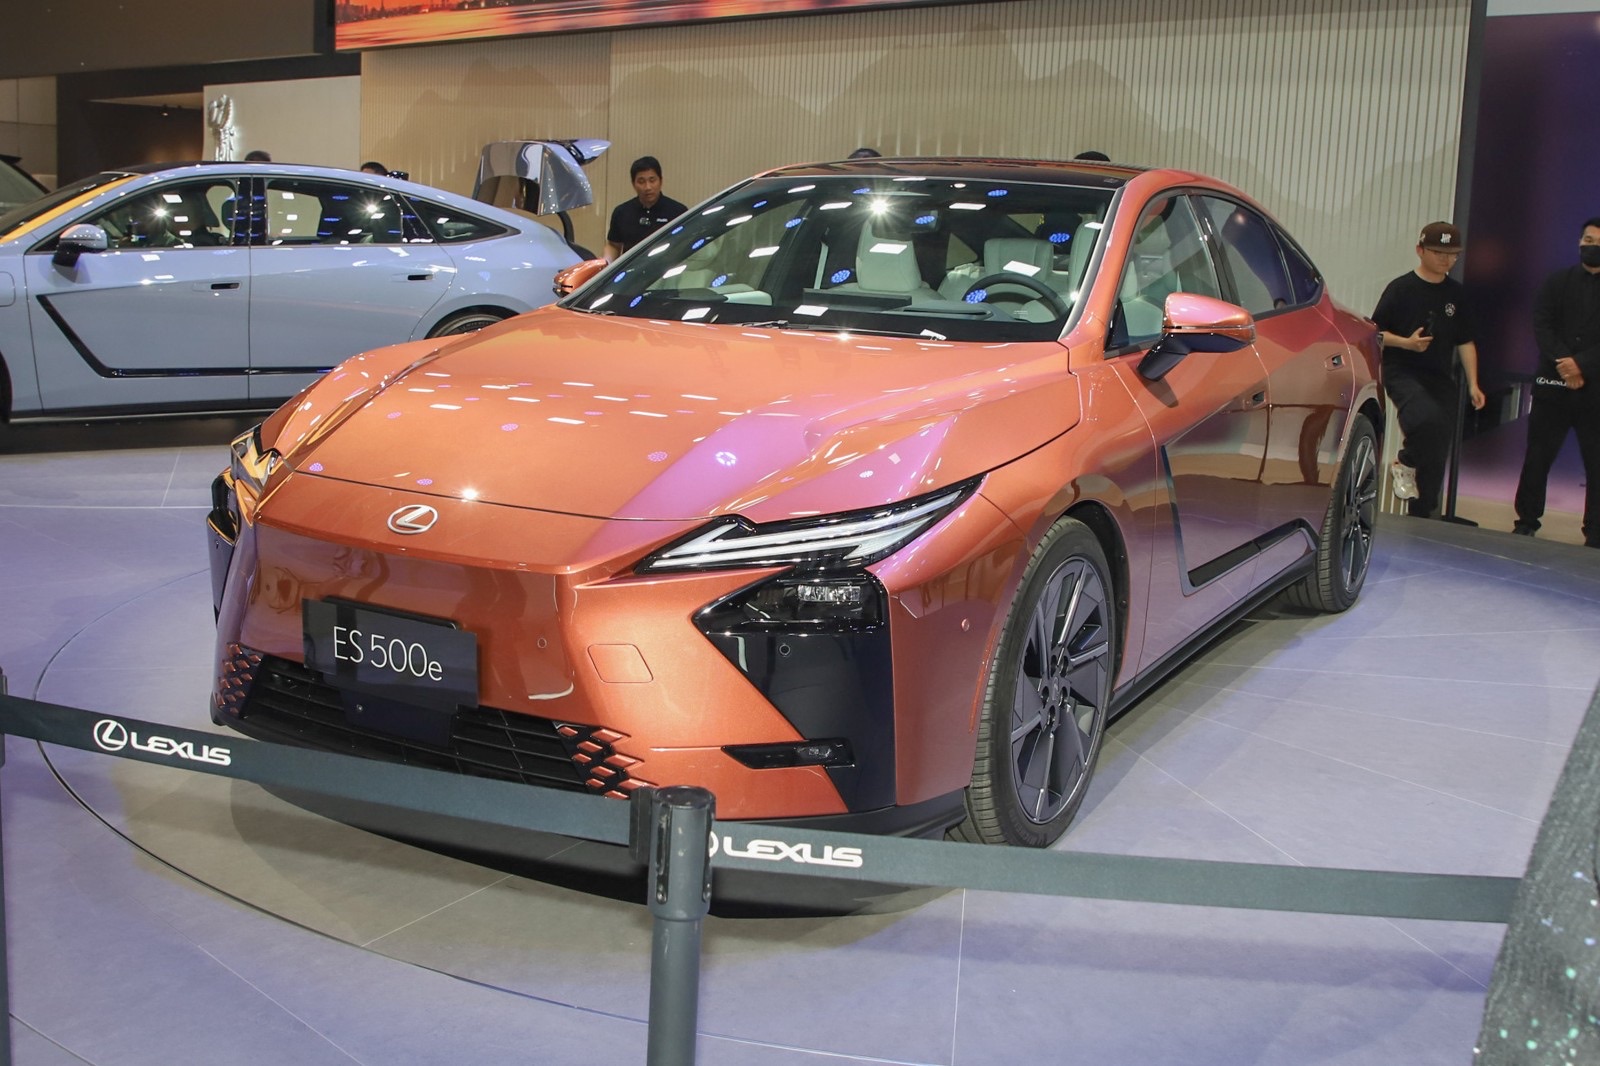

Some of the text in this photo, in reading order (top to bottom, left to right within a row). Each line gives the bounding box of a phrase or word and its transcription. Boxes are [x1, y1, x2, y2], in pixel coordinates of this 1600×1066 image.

[333, 625, 443, 681] ES 500e
[130, 731, 232, 767] LEXUS
[723, 836, 863, 868] LEXUS
